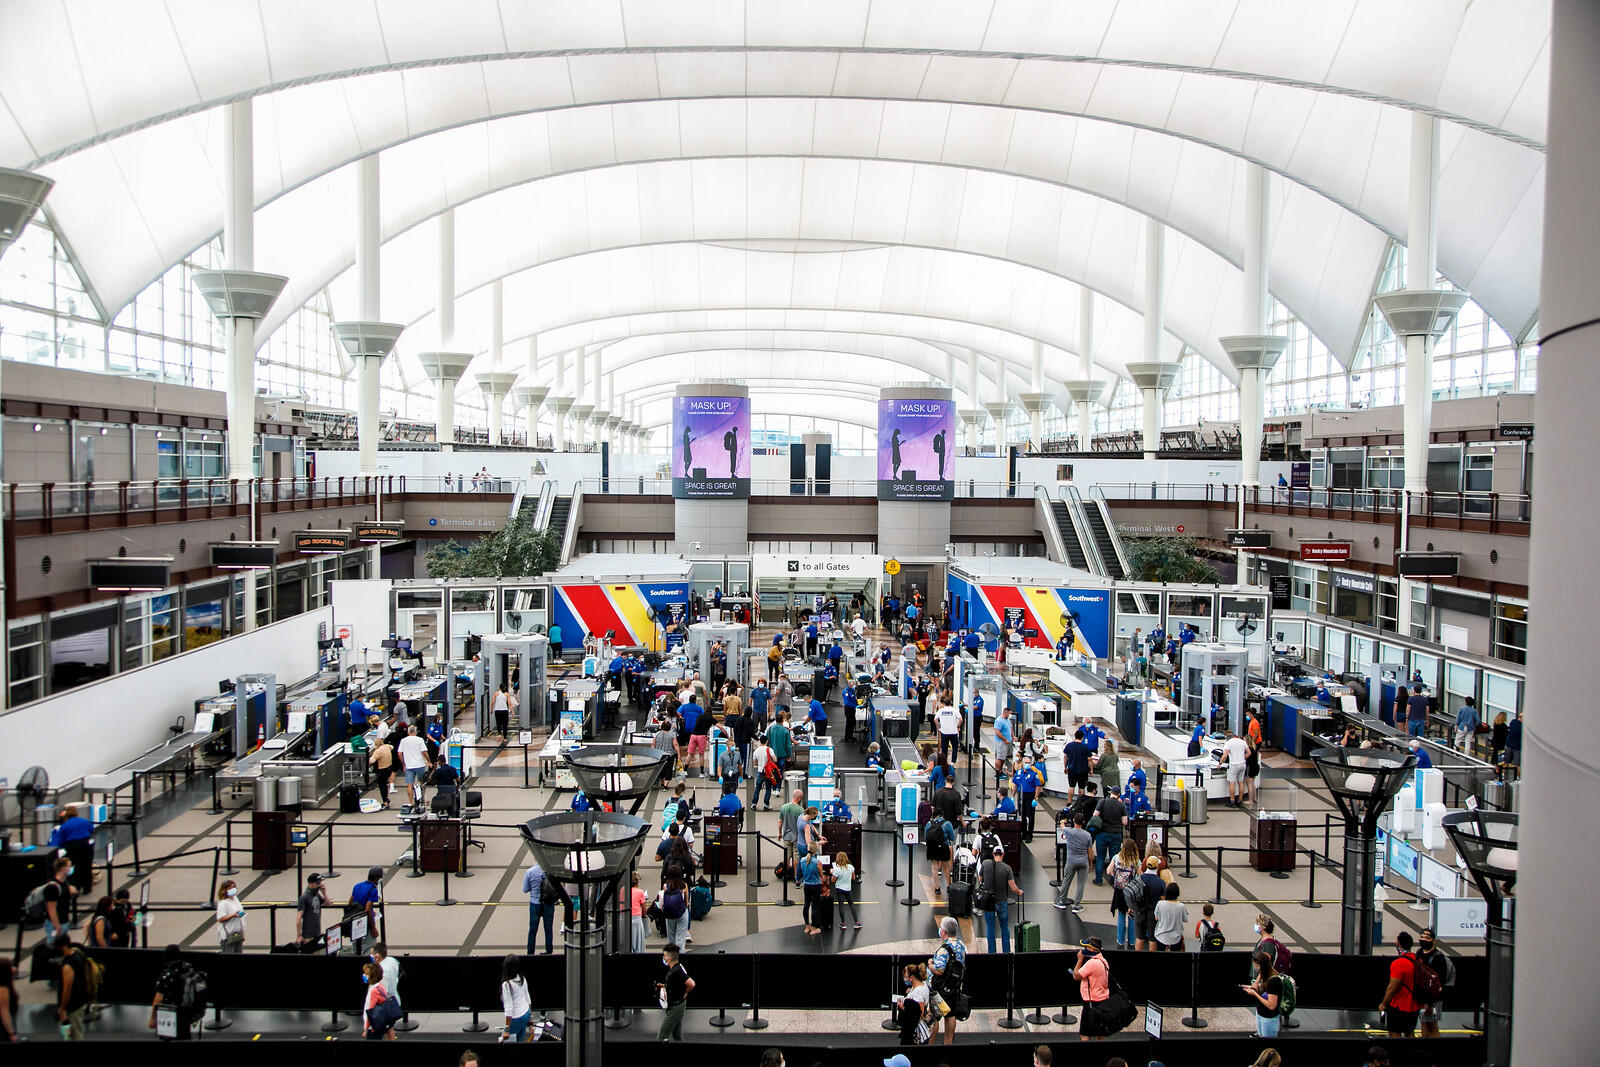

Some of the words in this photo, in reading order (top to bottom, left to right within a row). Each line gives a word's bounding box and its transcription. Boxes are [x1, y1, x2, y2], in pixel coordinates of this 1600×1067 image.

[690, 401, 715, 410] MASK
[717, 401, 732, 410] UP!
[900, 404, 925, 413] MASK
[926, 404, 940, 413] UP!
[684, 482, 705, 490] SPACE
[706, 482, 713, 490] IS
[714, 482, 737, 490] GREAT!
[893, 484, 914, 492] SPACE
[915, 484, 922, 492] IS
[923, 484, 945, 492] GREAT!
[1154, 524, 1175, 533] West
[802, 563, 812, 571] to
[813, 562, 824, 571] all
[826, 562, 850, 571] Gates
[1068, 594, 1100, 602] Southwest
[1431, 881, 1445, 892] CLEAR
